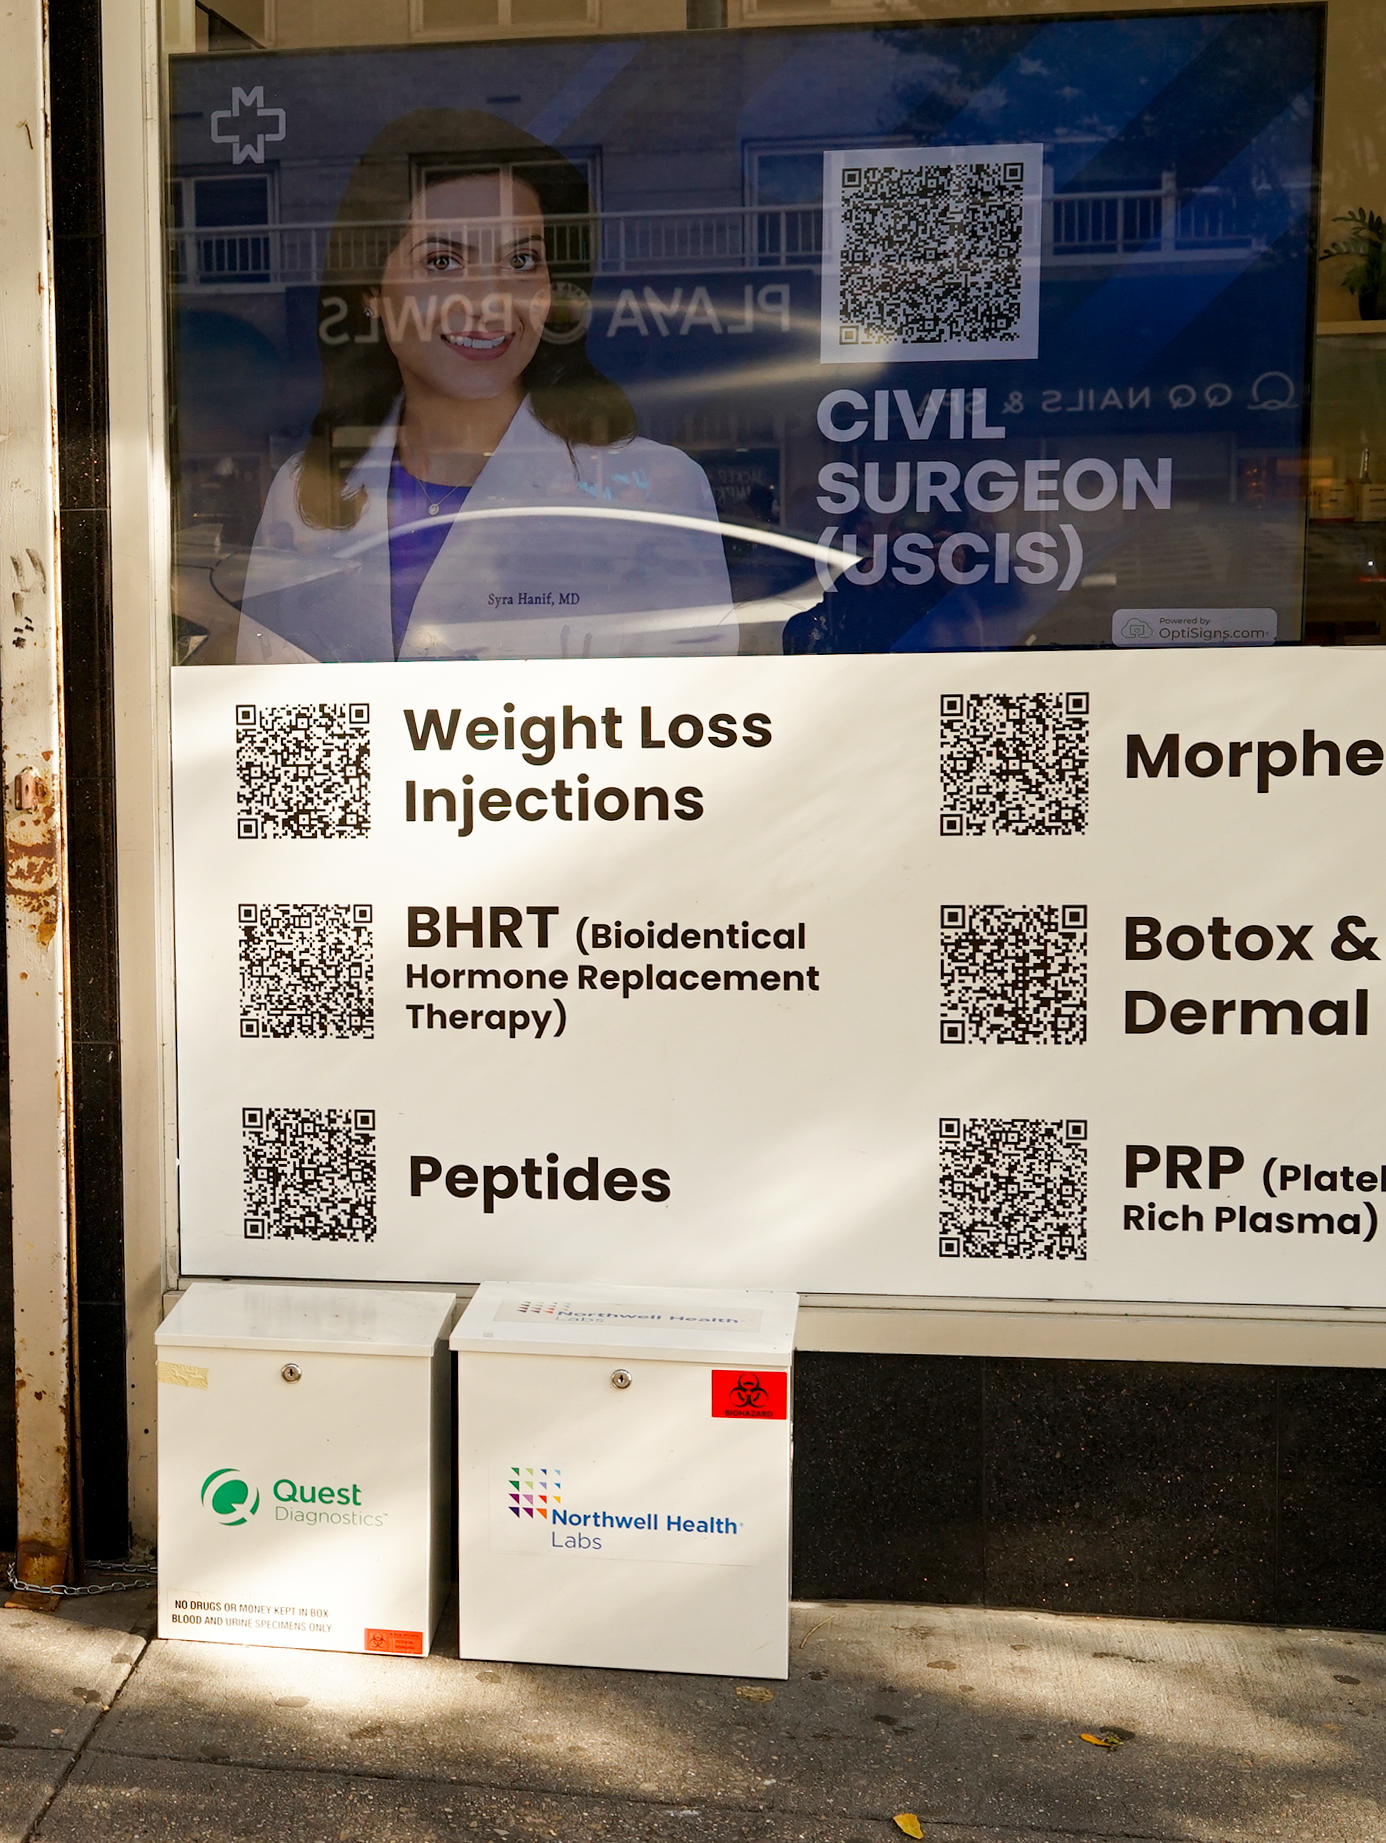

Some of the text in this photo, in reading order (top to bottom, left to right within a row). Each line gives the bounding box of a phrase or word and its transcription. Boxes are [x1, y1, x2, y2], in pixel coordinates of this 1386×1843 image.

[816, 387, 1006, 443] CIVIL
[816, 457, 1173, 515] SURGEON
[817, 524, 1084, 593] (USCIS)
[488, 592, 580, 607] Syra Hanif, MD
[1159, 617, 1211, 626] Powered by
[1159, 627, 1265, 641] OptiSigns.com
[403, 702, 773, 765] Weight Loss
[1126, 730, 1386, 793] Morphe
[404, 774, 704, 837] Injections
[406, 905, 806, 955] BHRT (Bioidentical
[1125, 916, 1381, 962] Botox &
[406, 964, 820, 998] Hormone Replacement
[406, 1000, 566, 1039] Therapy)
[1125, 988, 1368, 1036] Dermal
[410, 1154, 671, 1213] Peptides
[1125, 1144, 1244, 1190] PRP
[1124, 1202, 1378, 1243] Rich Plasma)
[555, 1316, 604, 1324] Labs
[557, 1311, 739, 1324] Northwell Health
[724, 1409, 774, 1418] BIOHAZARD
[273, 1479, 362, 1507] Quest
[551, 1531, 602, 1550] Labs
[552, 1508, 738, 1535] Northwell Health
[172, 1614, 332, 1633] BLOOD AND URINE SPECIMENS ONLY
[175, 1600, 329, 1618] NO DRUGS OR MONEY KEPT IN BOX
